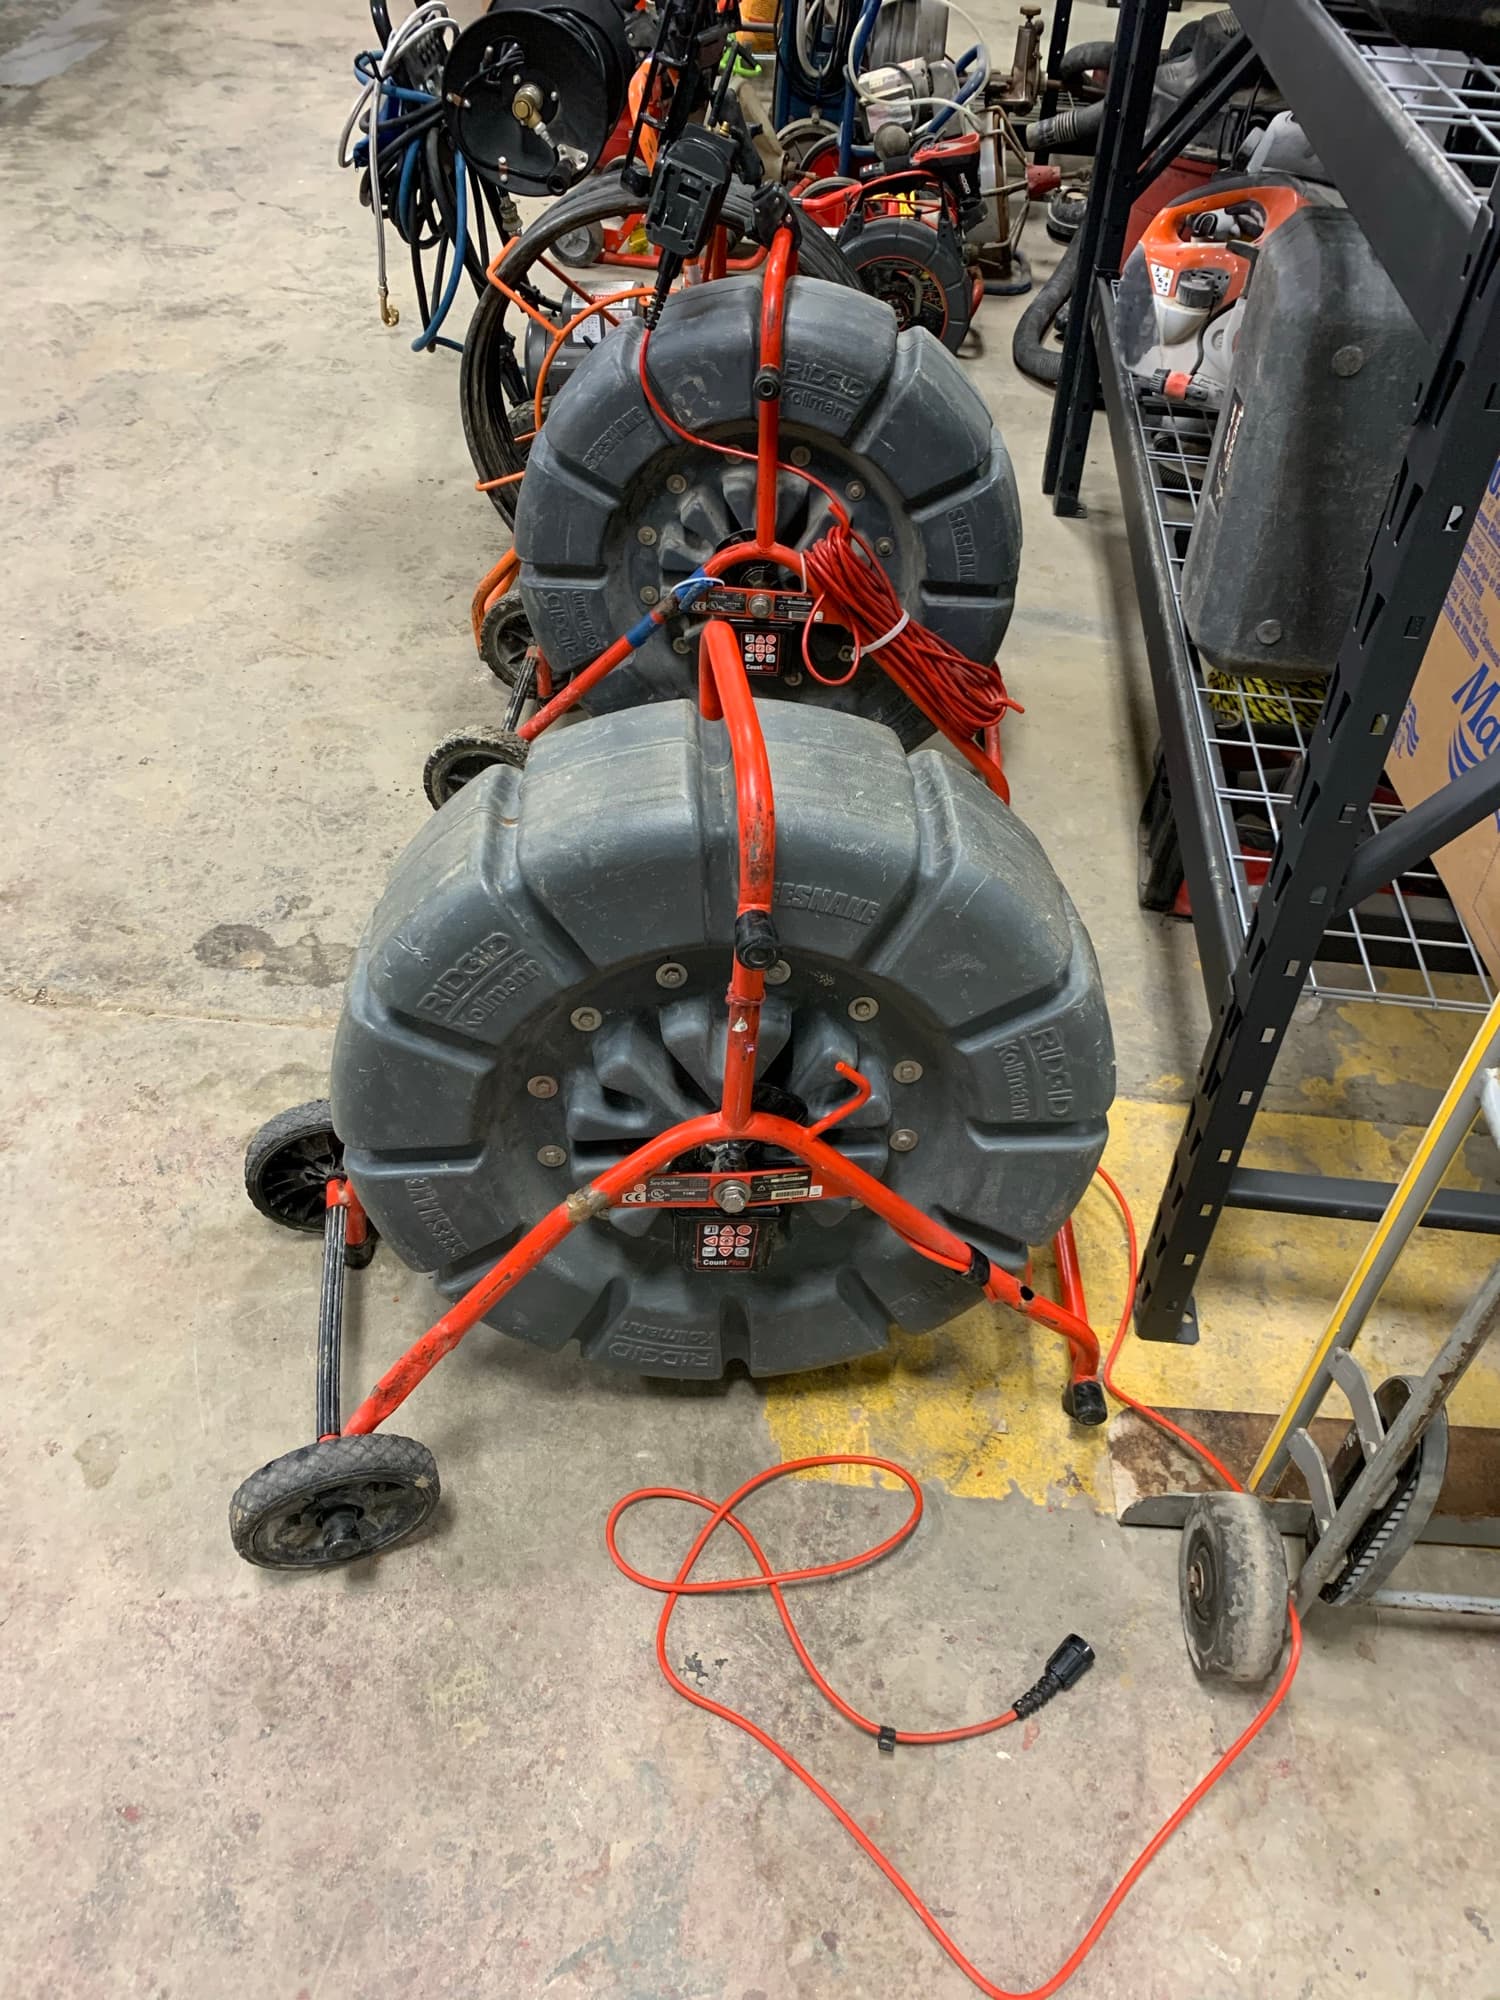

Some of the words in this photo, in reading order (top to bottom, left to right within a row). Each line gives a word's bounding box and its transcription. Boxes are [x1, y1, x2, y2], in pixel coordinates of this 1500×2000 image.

[416, 932, 512, 1015] RIDGID
[993, 1038, 1031, 1119] Kollmann
[1031, 1026, 1073, 1117] RIDGID
